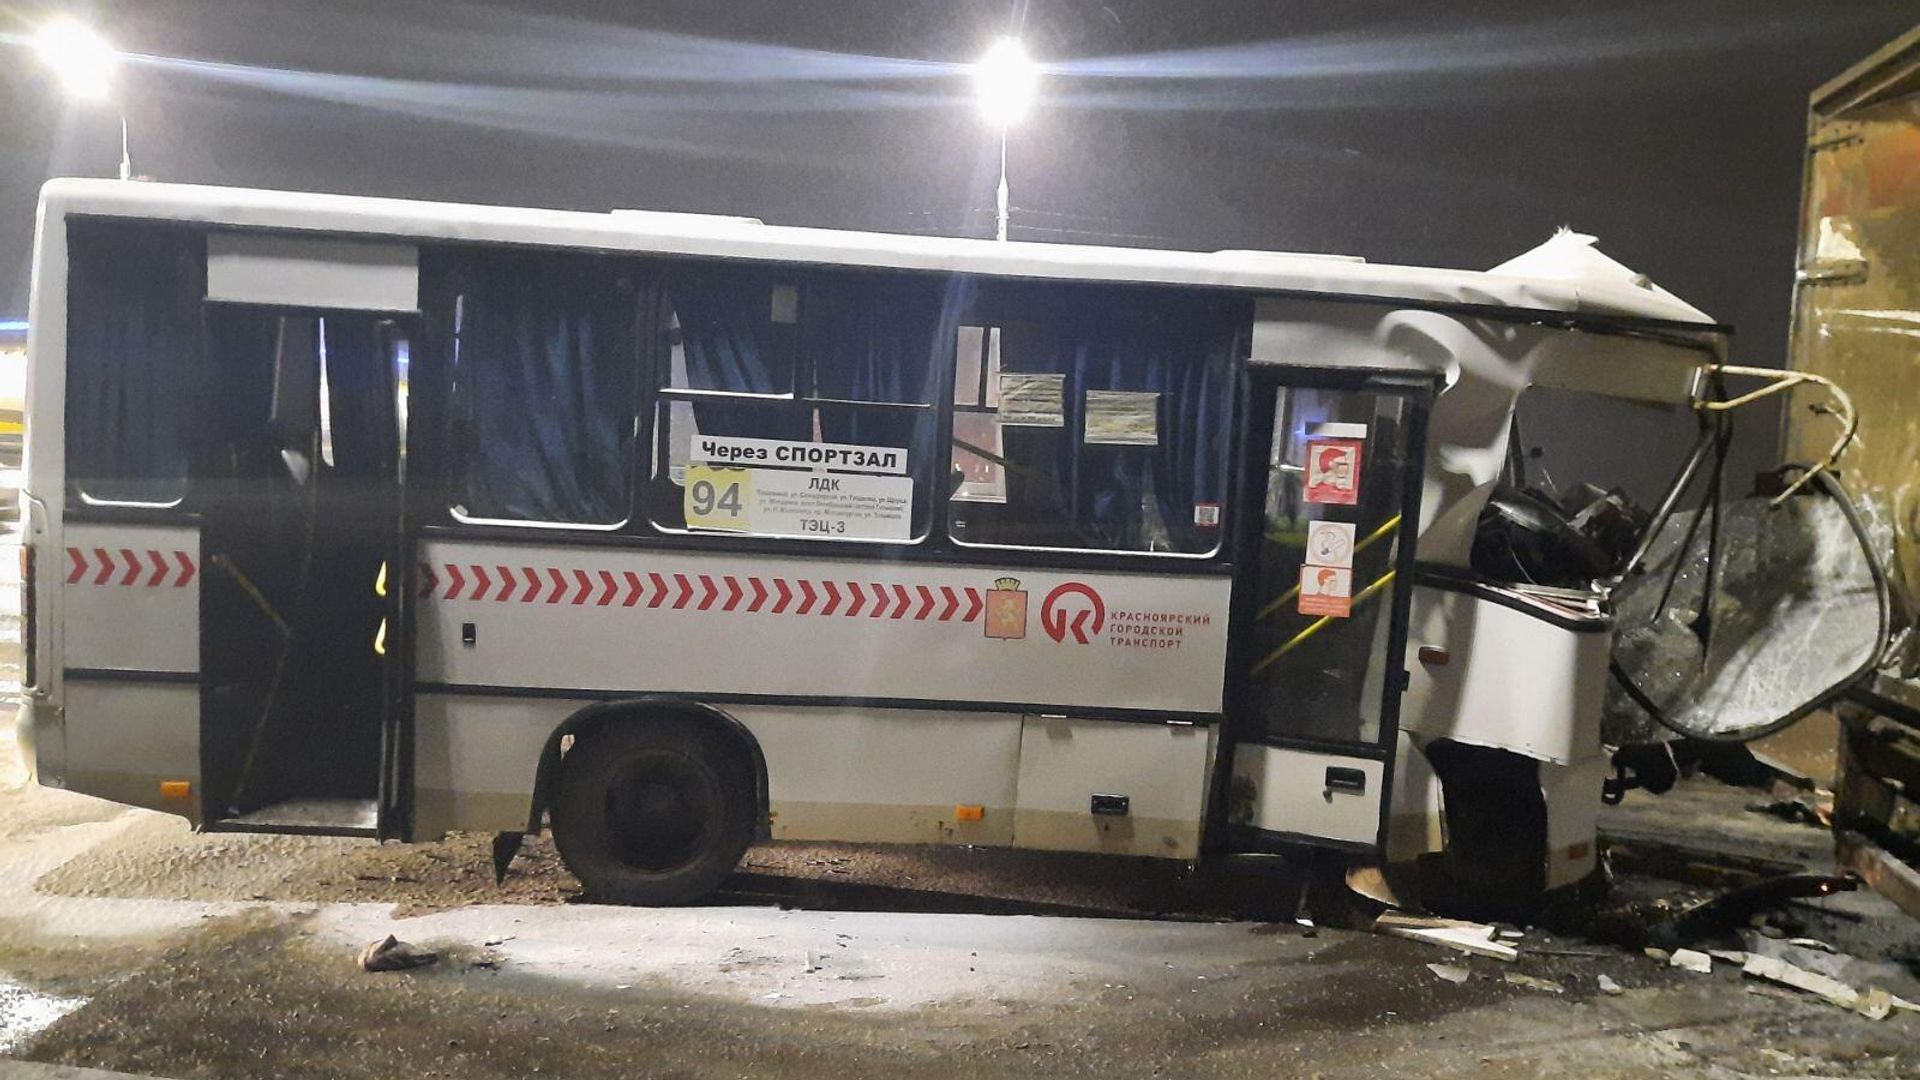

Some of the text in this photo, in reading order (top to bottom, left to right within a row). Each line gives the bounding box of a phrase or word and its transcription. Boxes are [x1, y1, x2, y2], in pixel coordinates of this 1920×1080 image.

[701, 441, 898, 468] Через СПОРТЗАЛ
[808, 477, 841, 492] ЛДК
[692, 480, 743, 518] 94
[799, 519, 846, 534] ТЭЦ-3
[1110, 611, 1211, 625] КРАСНОЯРСКИЙ
[1110, 623, 1184, 636] ГОРОДСКОЙ
[1110, 636, 1182, 650] ТРАНСПОРТ
